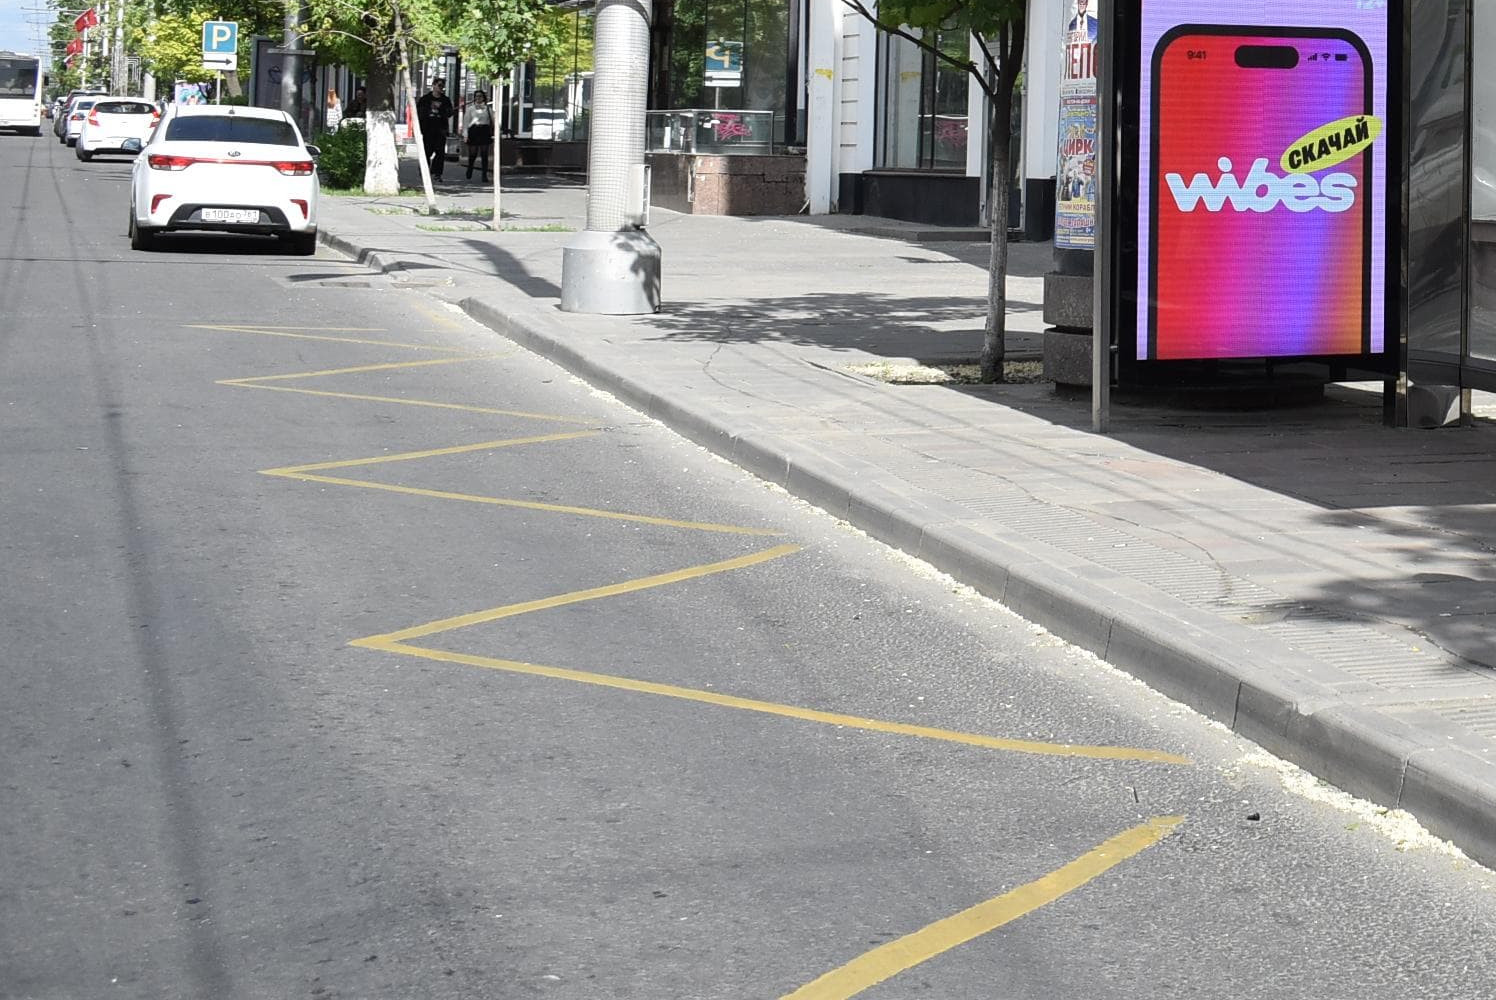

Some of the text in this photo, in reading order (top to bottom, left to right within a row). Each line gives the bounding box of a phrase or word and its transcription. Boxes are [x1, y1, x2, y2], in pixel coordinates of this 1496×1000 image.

[212, 25, 231, 50] P
[1186, 50, 1207, 60] 9:41
[1062, 138, 1094, 156] ЦИРК
[1288, 116, 1370, 170] СКАЧАЙ
[1164, 156, 1358, 213] wibes
